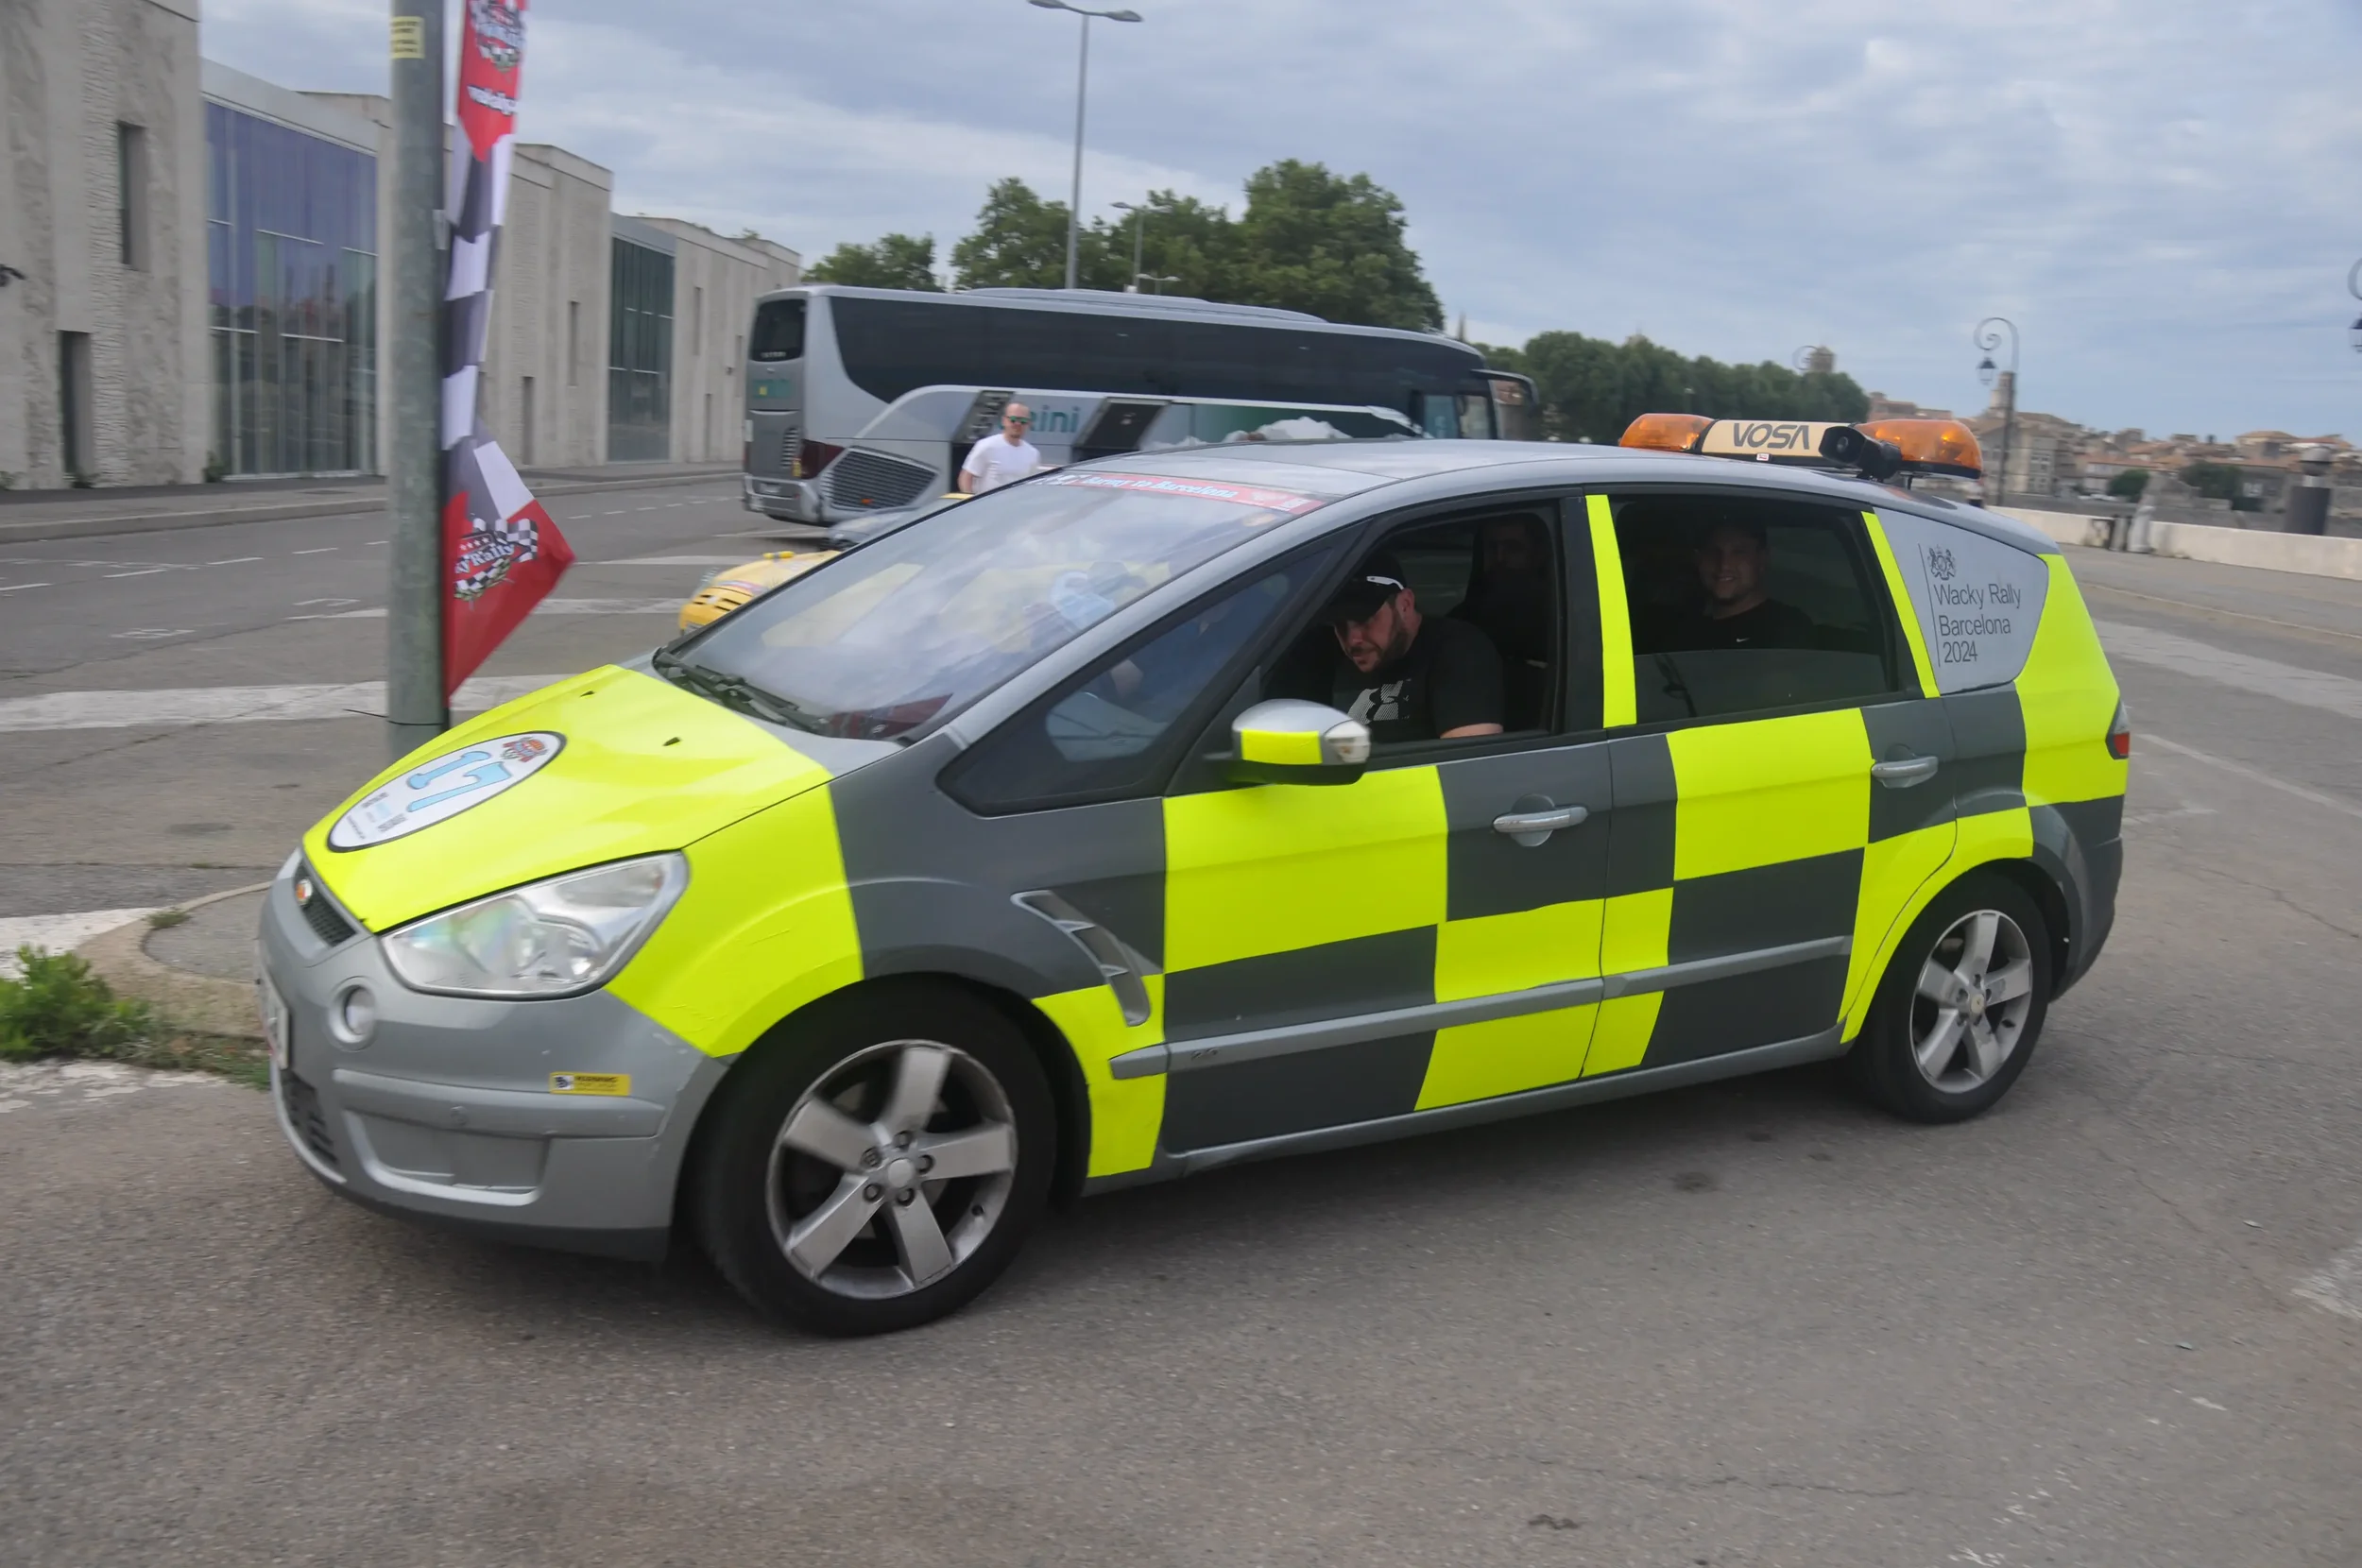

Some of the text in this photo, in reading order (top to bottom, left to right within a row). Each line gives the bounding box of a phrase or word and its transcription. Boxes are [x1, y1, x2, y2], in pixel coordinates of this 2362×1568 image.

[1734, 422, 1810, 450] VOSA
[1151, 480, 1240, 498] Barcelona
[1933, 583, 2021, 610] Wacky Rally
[1939, 613, 2011, 637] Barcelona
[1943, 639, 1978, 663] 2024
[408, 751, 511, 812] 17
